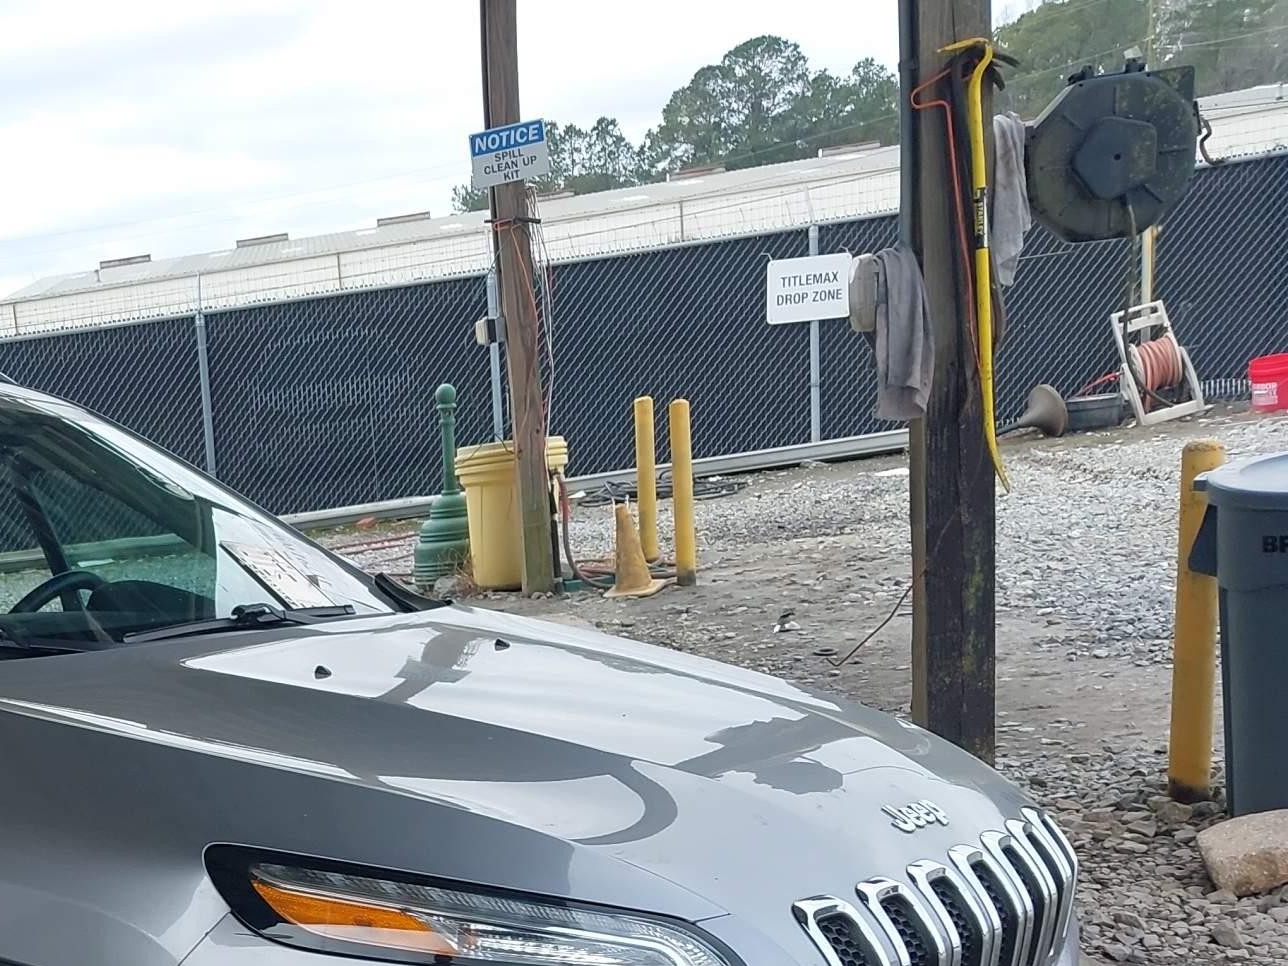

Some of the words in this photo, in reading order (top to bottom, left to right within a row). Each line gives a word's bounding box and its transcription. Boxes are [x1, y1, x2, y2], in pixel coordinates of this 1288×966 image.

[475, 124, 540, 153] NOTICE
[494, 148, 524, 162] SPILL
[483, 160, 519, 175] CLEAN
[522, 155, 537, 167] UP
[503, 169, 520, 181] KIT
[780, 271, 839, 288] TITLEMAX
[776, 292, 809, 306] DROP
[812, 288, 843, 302] ZONE
[880, 800, 949, 834] Jeep
